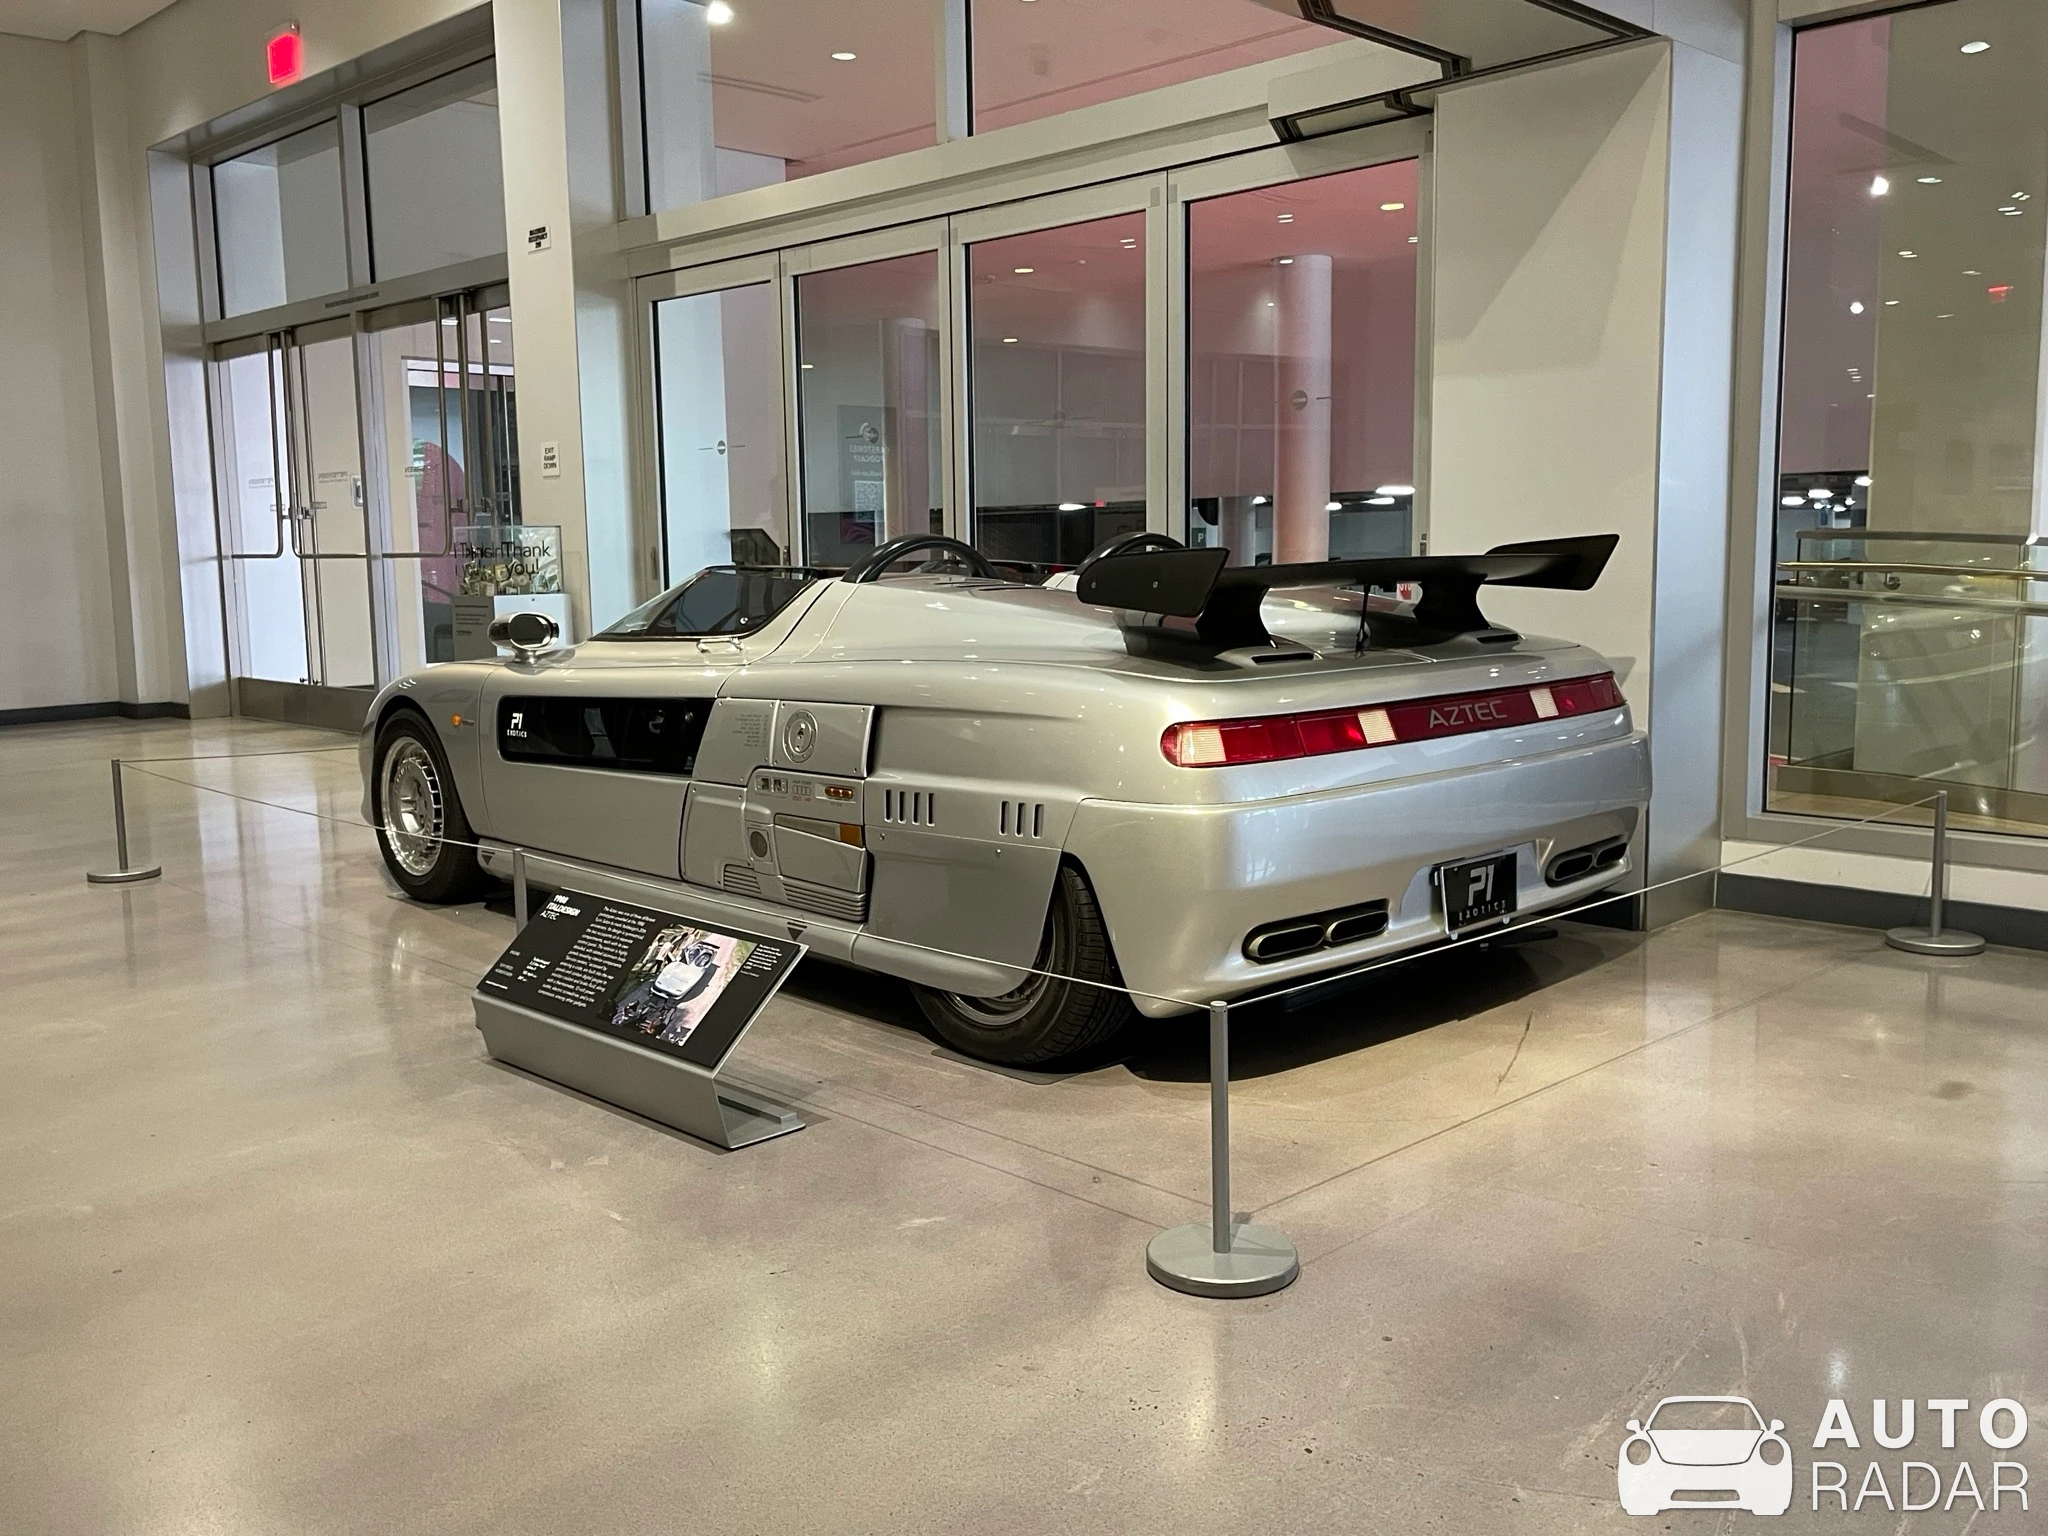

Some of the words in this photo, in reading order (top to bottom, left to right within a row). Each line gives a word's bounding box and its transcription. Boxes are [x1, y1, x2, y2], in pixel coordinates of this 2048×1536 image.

[501, 540, 551, 558] Thank
[505, 558, 540, 581] you!
[510, 712, 523, 729] P1
[1429, 700, 1508, 729] AZTEC
[507, 729, 527, 739] EXOTICS
[1468, 864, 1495, 907] P1
[540, 910, 560, 920] AZTEC
[1459, 900, 1506, 921] EXOTICS
